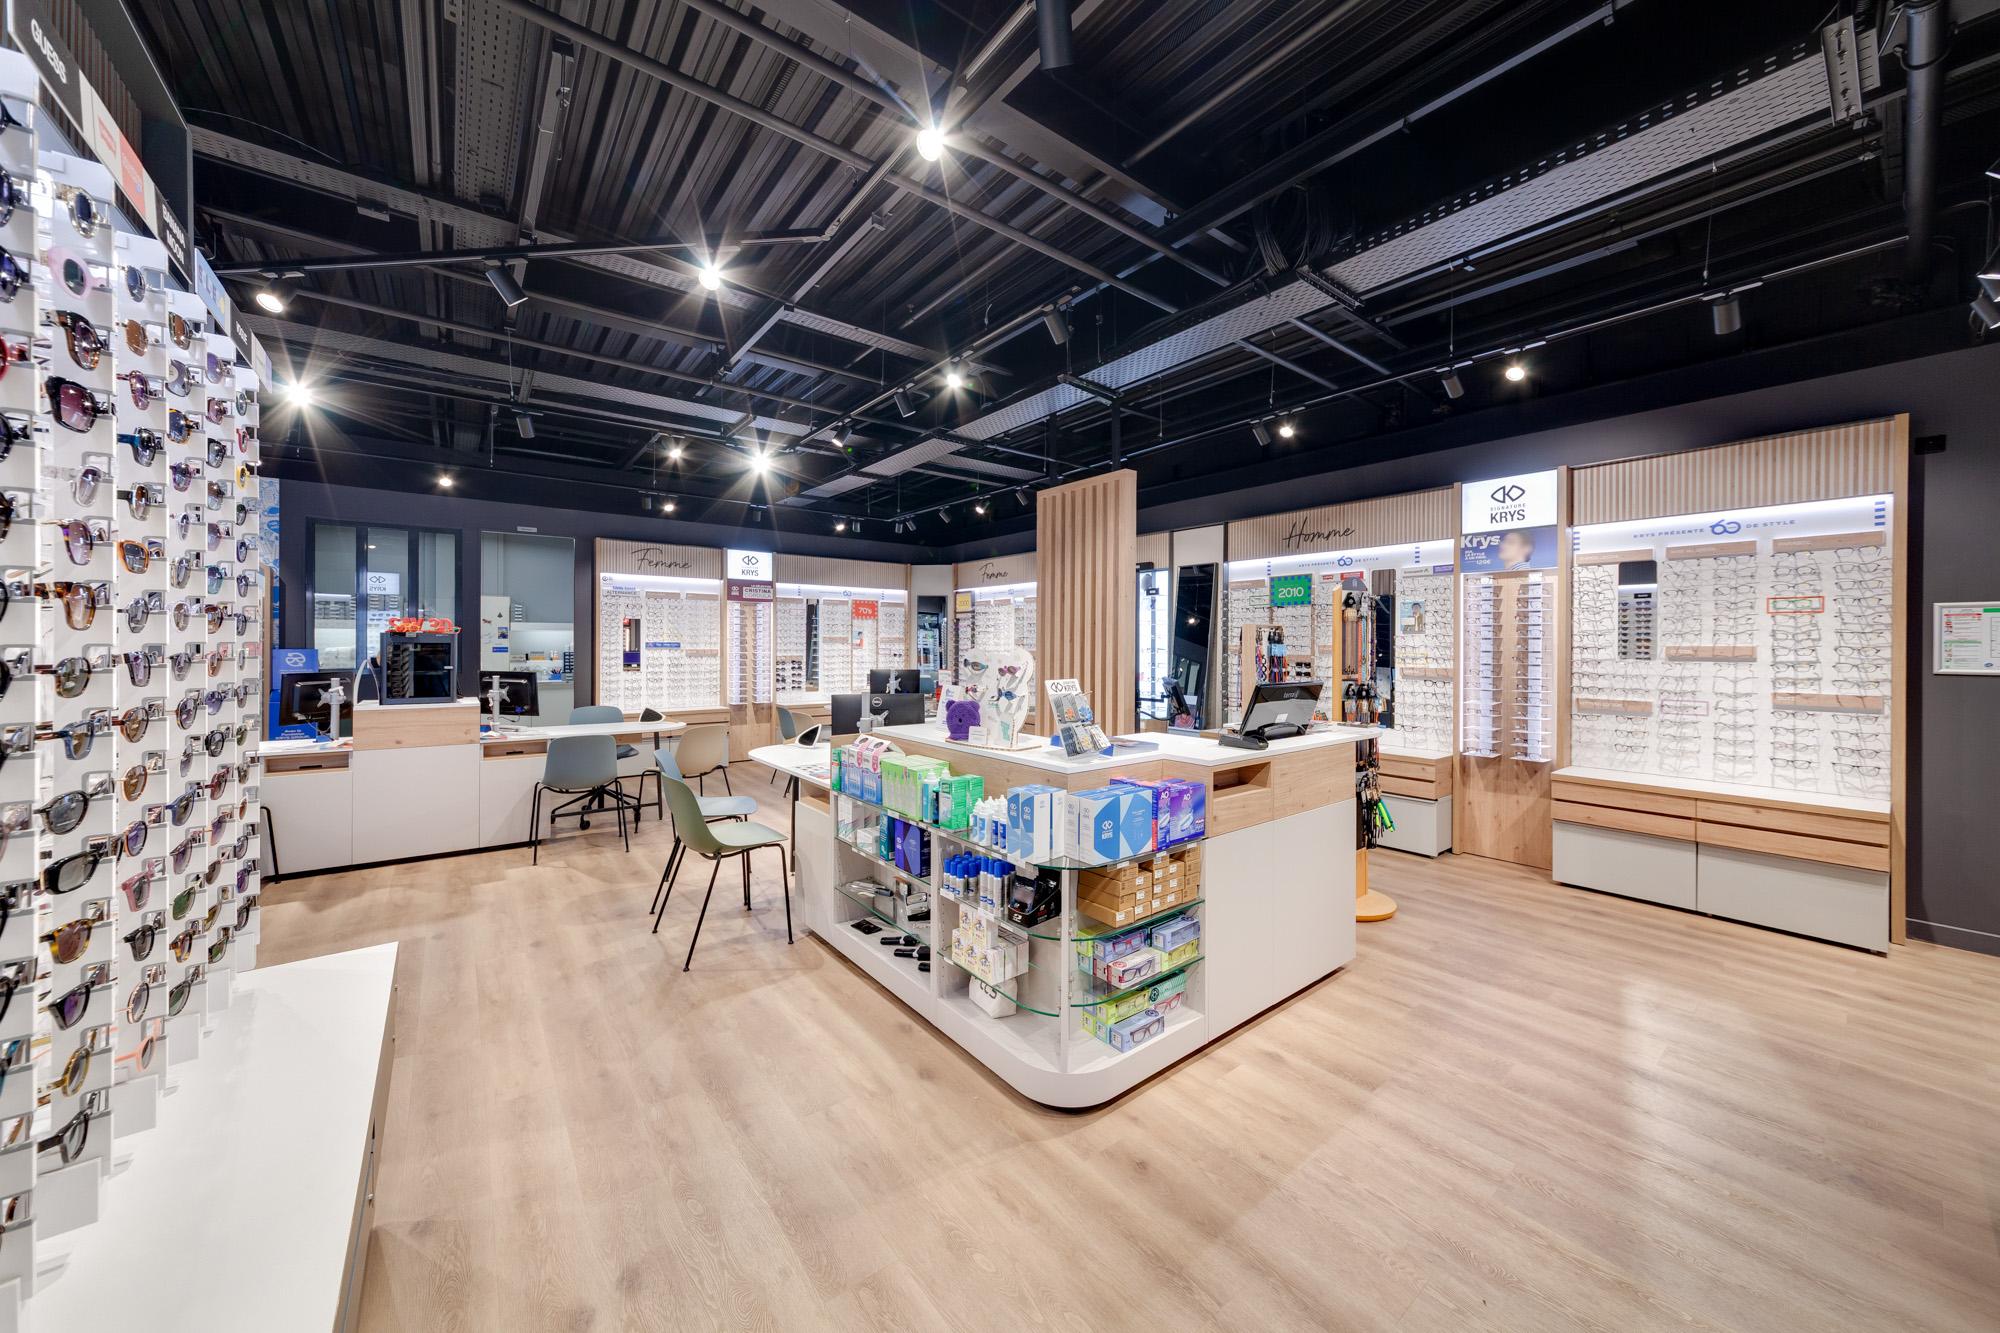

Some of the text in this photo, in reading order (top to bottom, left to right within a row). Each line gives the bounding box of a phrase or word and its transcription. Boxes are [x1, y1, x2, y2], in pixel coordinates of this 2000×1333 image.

[31, 18, 67, 83] GUESS
[166, 229, 185, 264] MOON
[1490, 503, 1526, 511] SIGNATURE
[1490, 509, 1526, 524] KRYS
[1282, 516, 1355, 549] Homme
[1709, 519, 1741, 535] 60
[1460, 535, 1500, 549] Krys
[631, 547, 692, 570] Femme
[1337, 556, 1353, 566] 60
[741, 569, 759, 577] KRYS
[1278, 587, 1304, 598] 2010
